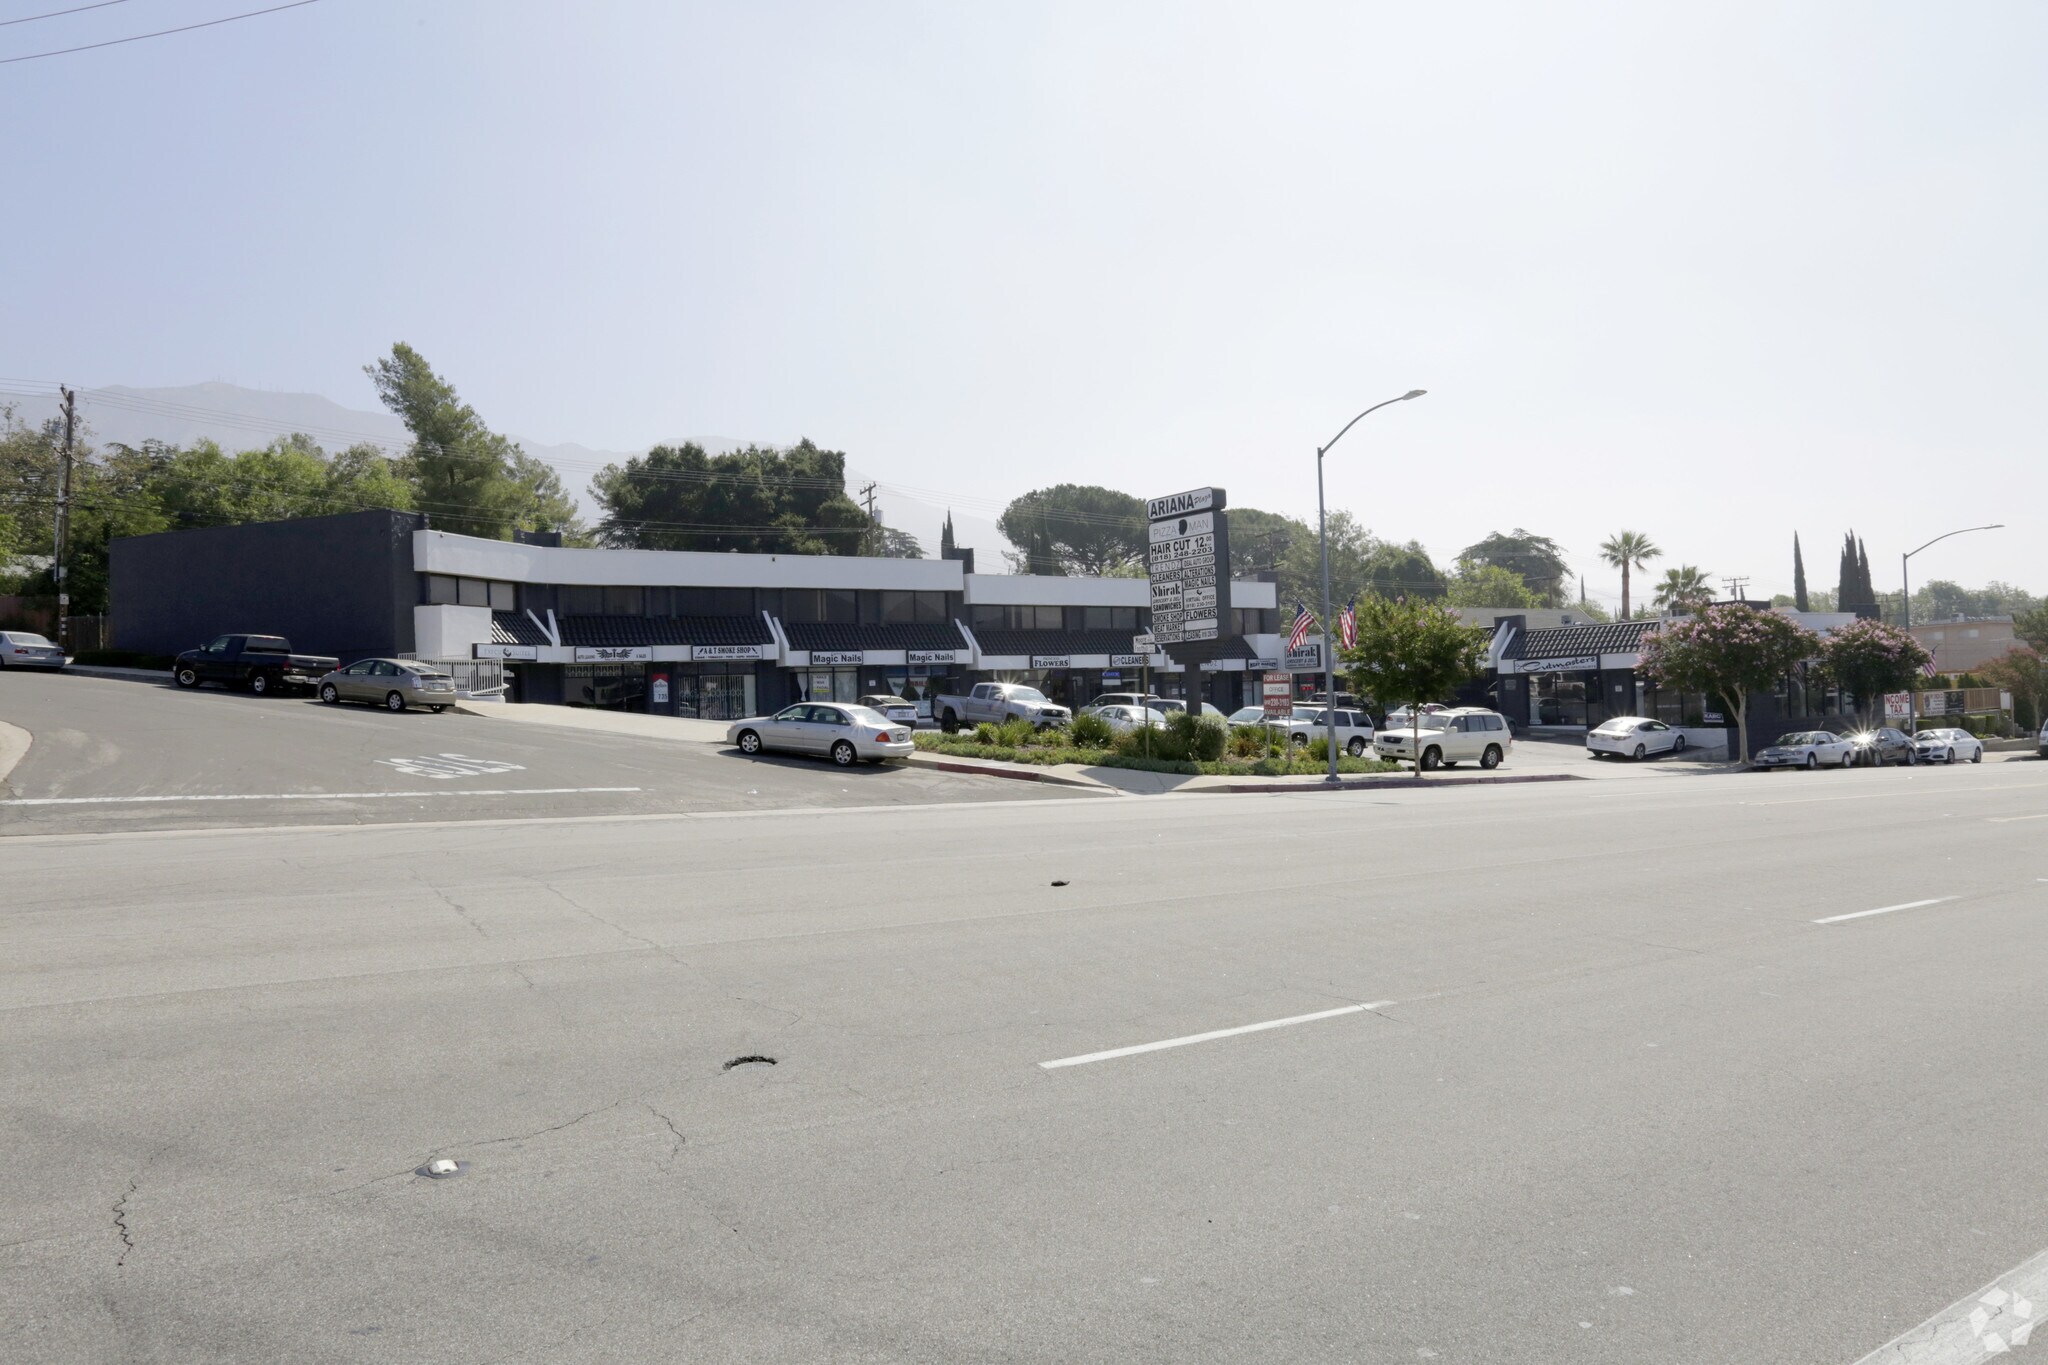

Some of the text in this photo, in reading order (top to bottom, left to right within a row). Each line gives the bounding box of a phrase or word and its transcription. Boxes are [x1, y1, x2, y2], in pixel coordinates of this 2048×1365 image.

[1150, 494, 1194, 518] ARIANA
[1153, 519, 1209, 538] PIZZA MAN
[1151, 542, 1171, 556] HAIR
[1173, 539, 1191, 552] CUT
[1151, 546, 1213, 562] (818) 248-2203
[1152, 571, 1180, 583] CLEANERS
[1184, 566, 1214, 578] ALTERATIONS
[1184, 576, 1214, 588] MAGIC NAILS
[1152, 583, 1181, 598] Shirak
[1153, 602, 1181, 612] SANDWICHES
[1154, 612, 1182, 623] SMOKE SHOP
[1186, 608, 1216, 619] FLOWERS
[1154, 622, 1183, 632] MEAT MARKET
[1155, 633, 1180, 642] RESERVATIONS
[814, 654, 839, 664] Magic
[841, 654, 862, 662] Nails
[909, 654, 932, 663] Magic
[1521, 656, 1596, 672] Cutmasters
[1890, 704, 1903, 714] TAX
